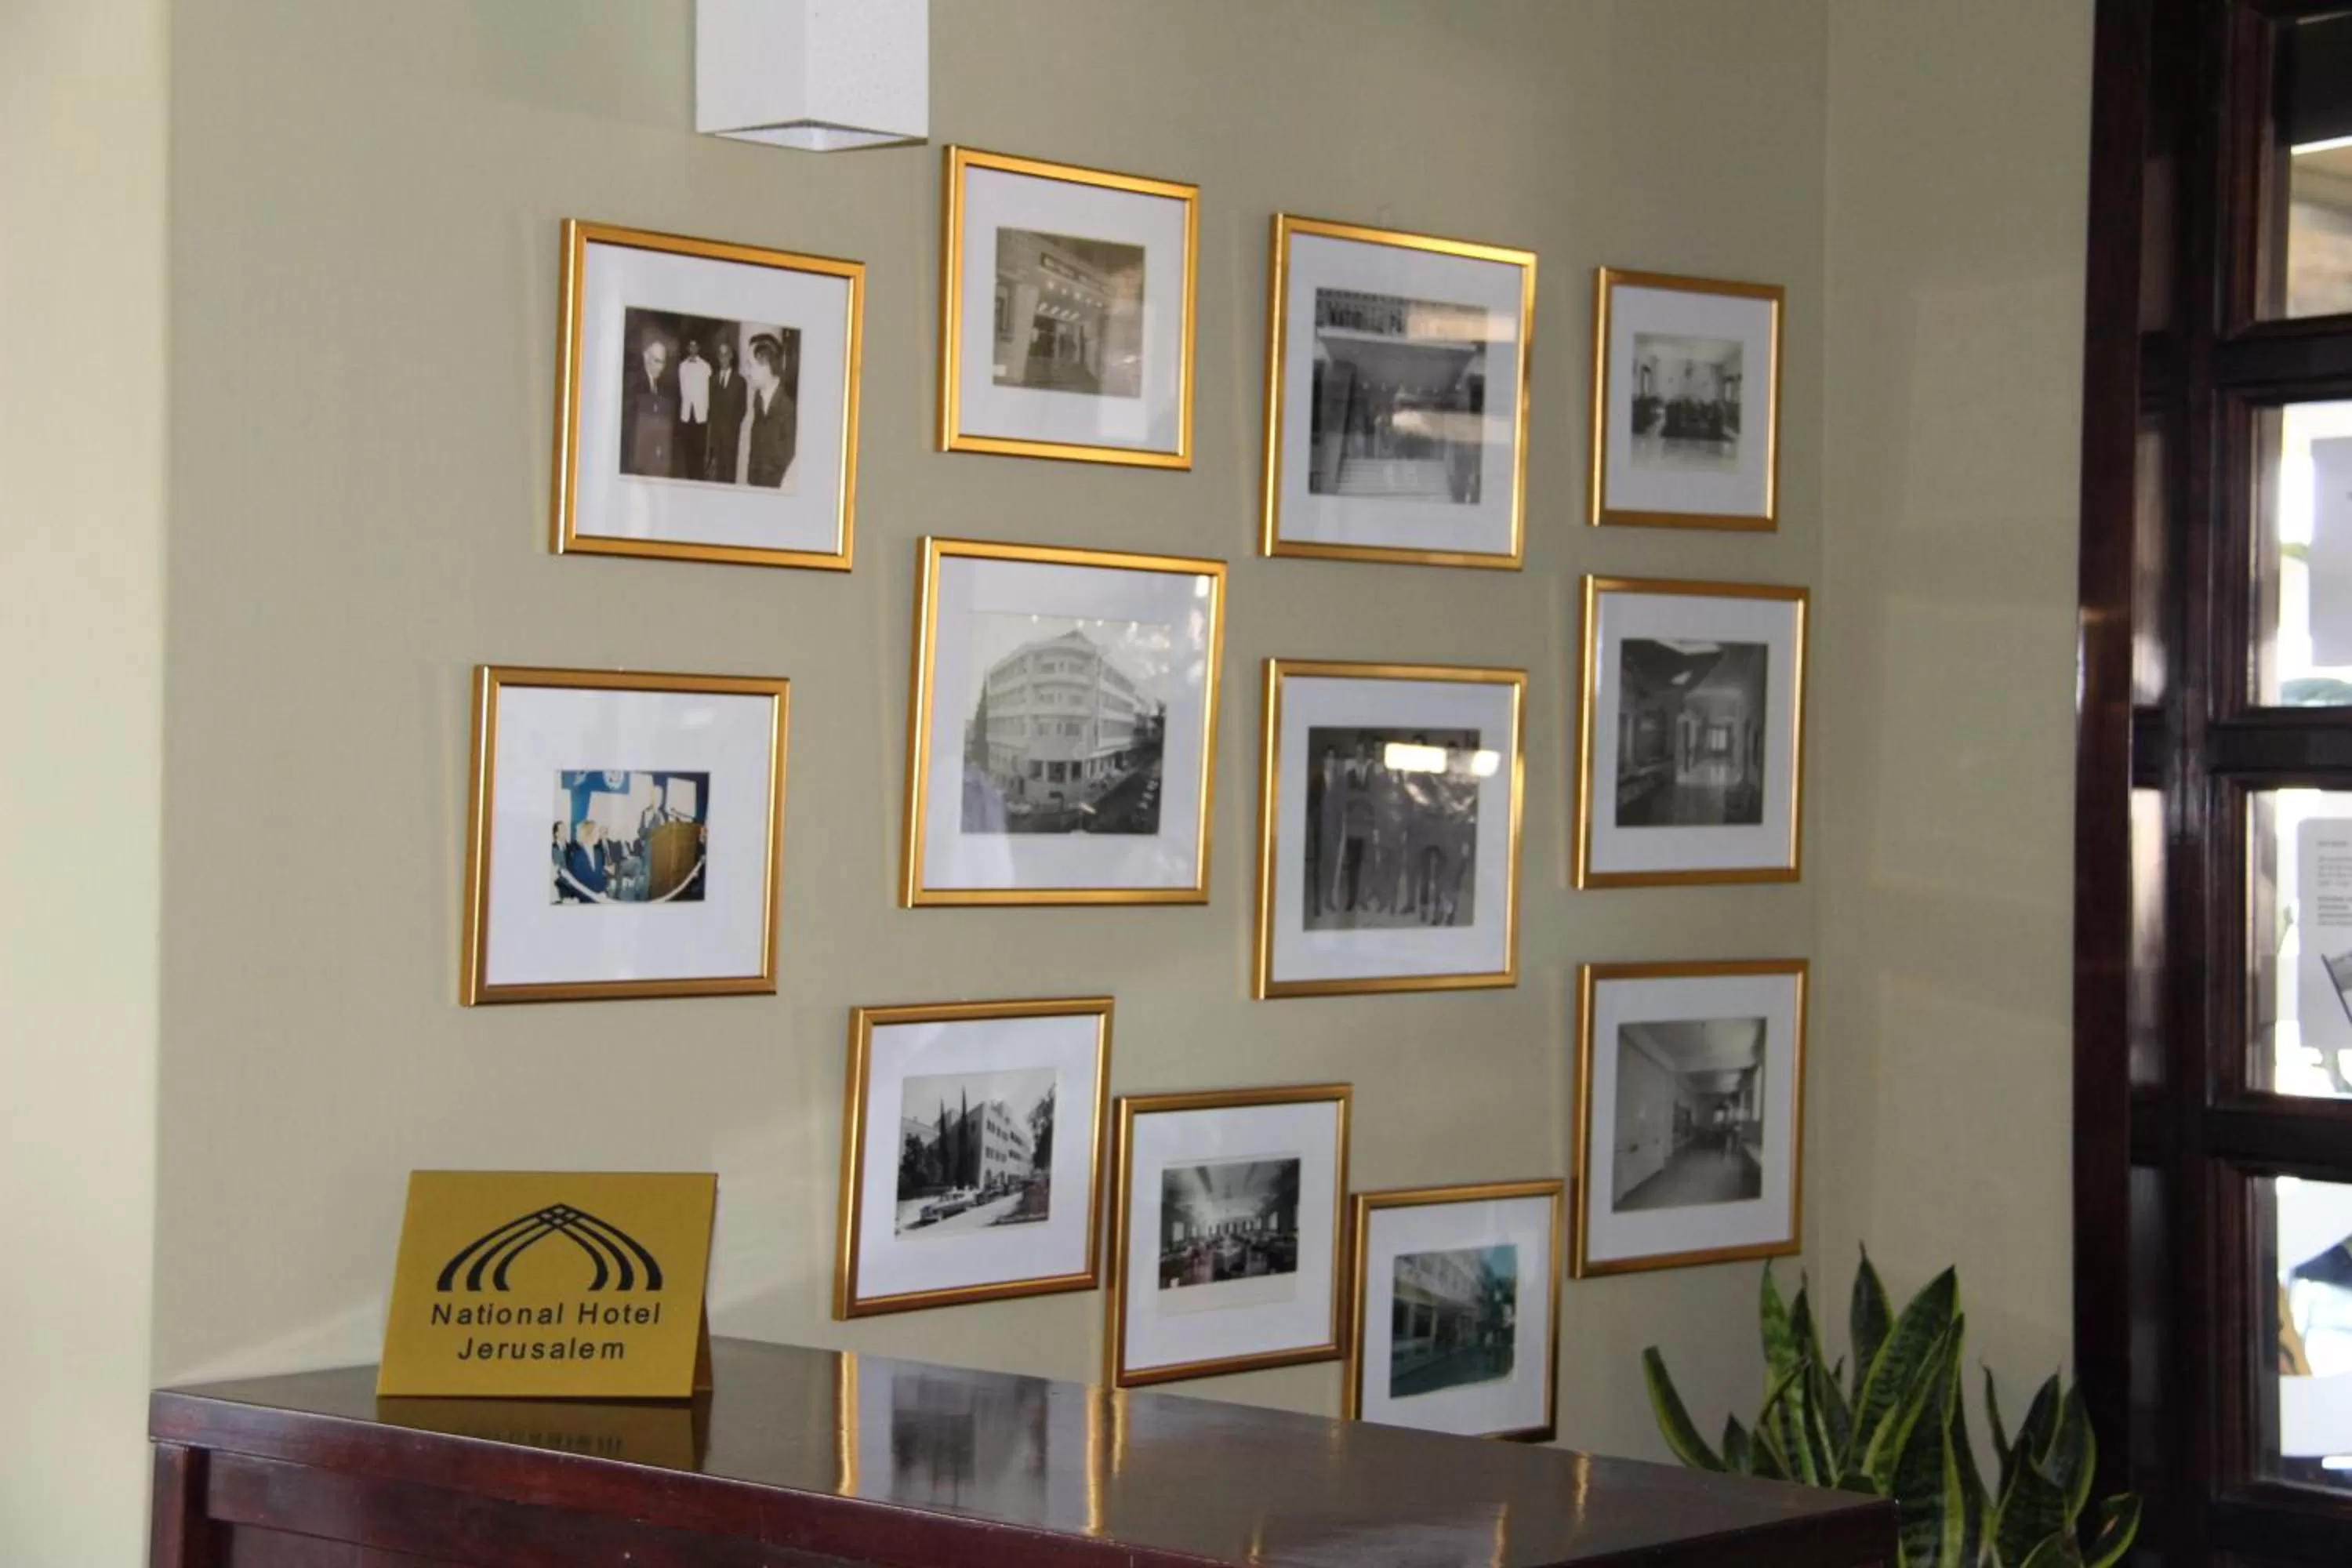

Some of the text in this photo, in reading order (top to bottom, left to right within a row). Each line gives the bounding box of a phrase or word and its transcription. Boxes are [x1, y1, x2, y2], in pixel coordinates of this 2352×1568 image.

[431, 1302, 660, 1325] National Hotel
[457, 1338, 624, 1360] Jerusalem
